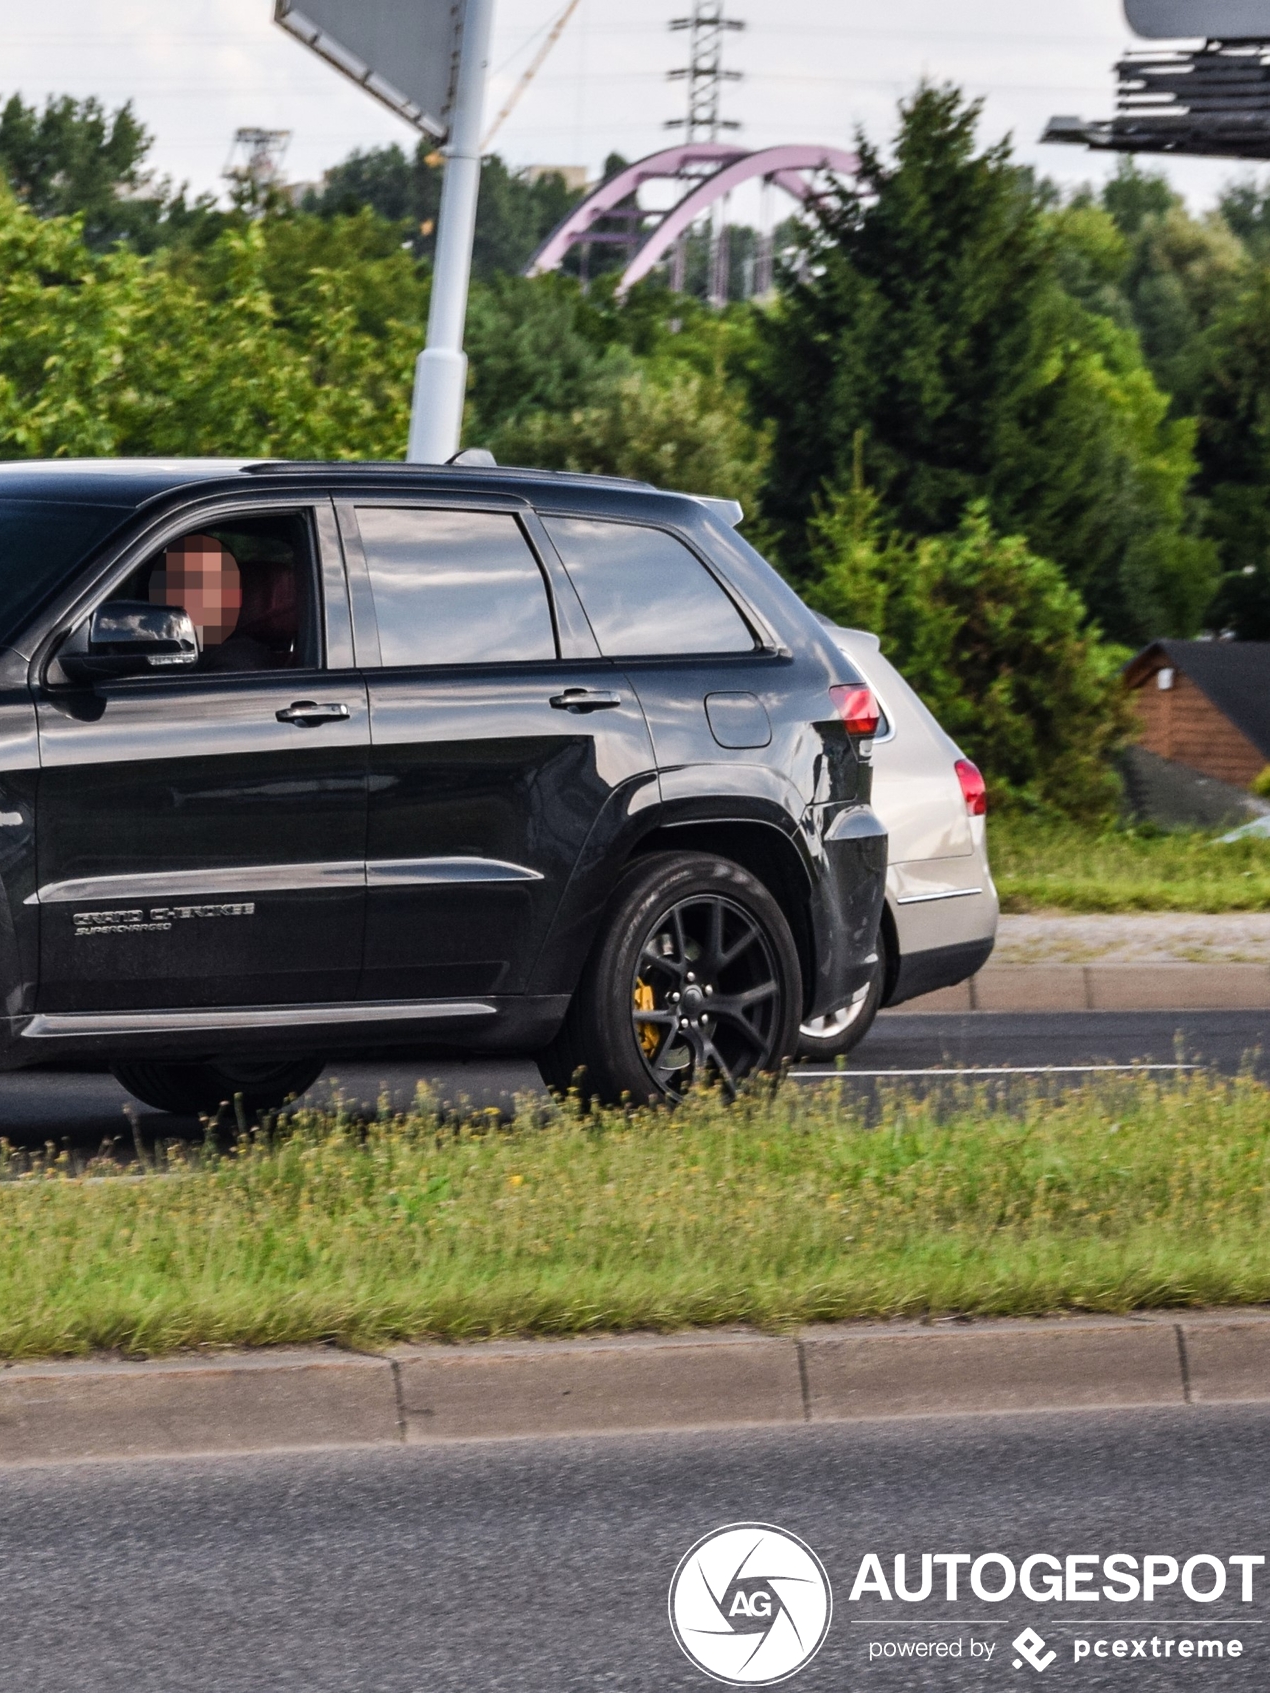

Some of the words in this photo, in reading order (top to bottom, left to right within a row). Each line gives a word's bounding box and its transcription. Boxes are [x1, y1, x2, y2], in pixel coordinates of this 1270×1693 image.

[73, 910, 143, 925] GRAND
[150, 903, 255, 920] CHEROKEE
[74, 922, 172, 936] SUPERCHARGED
